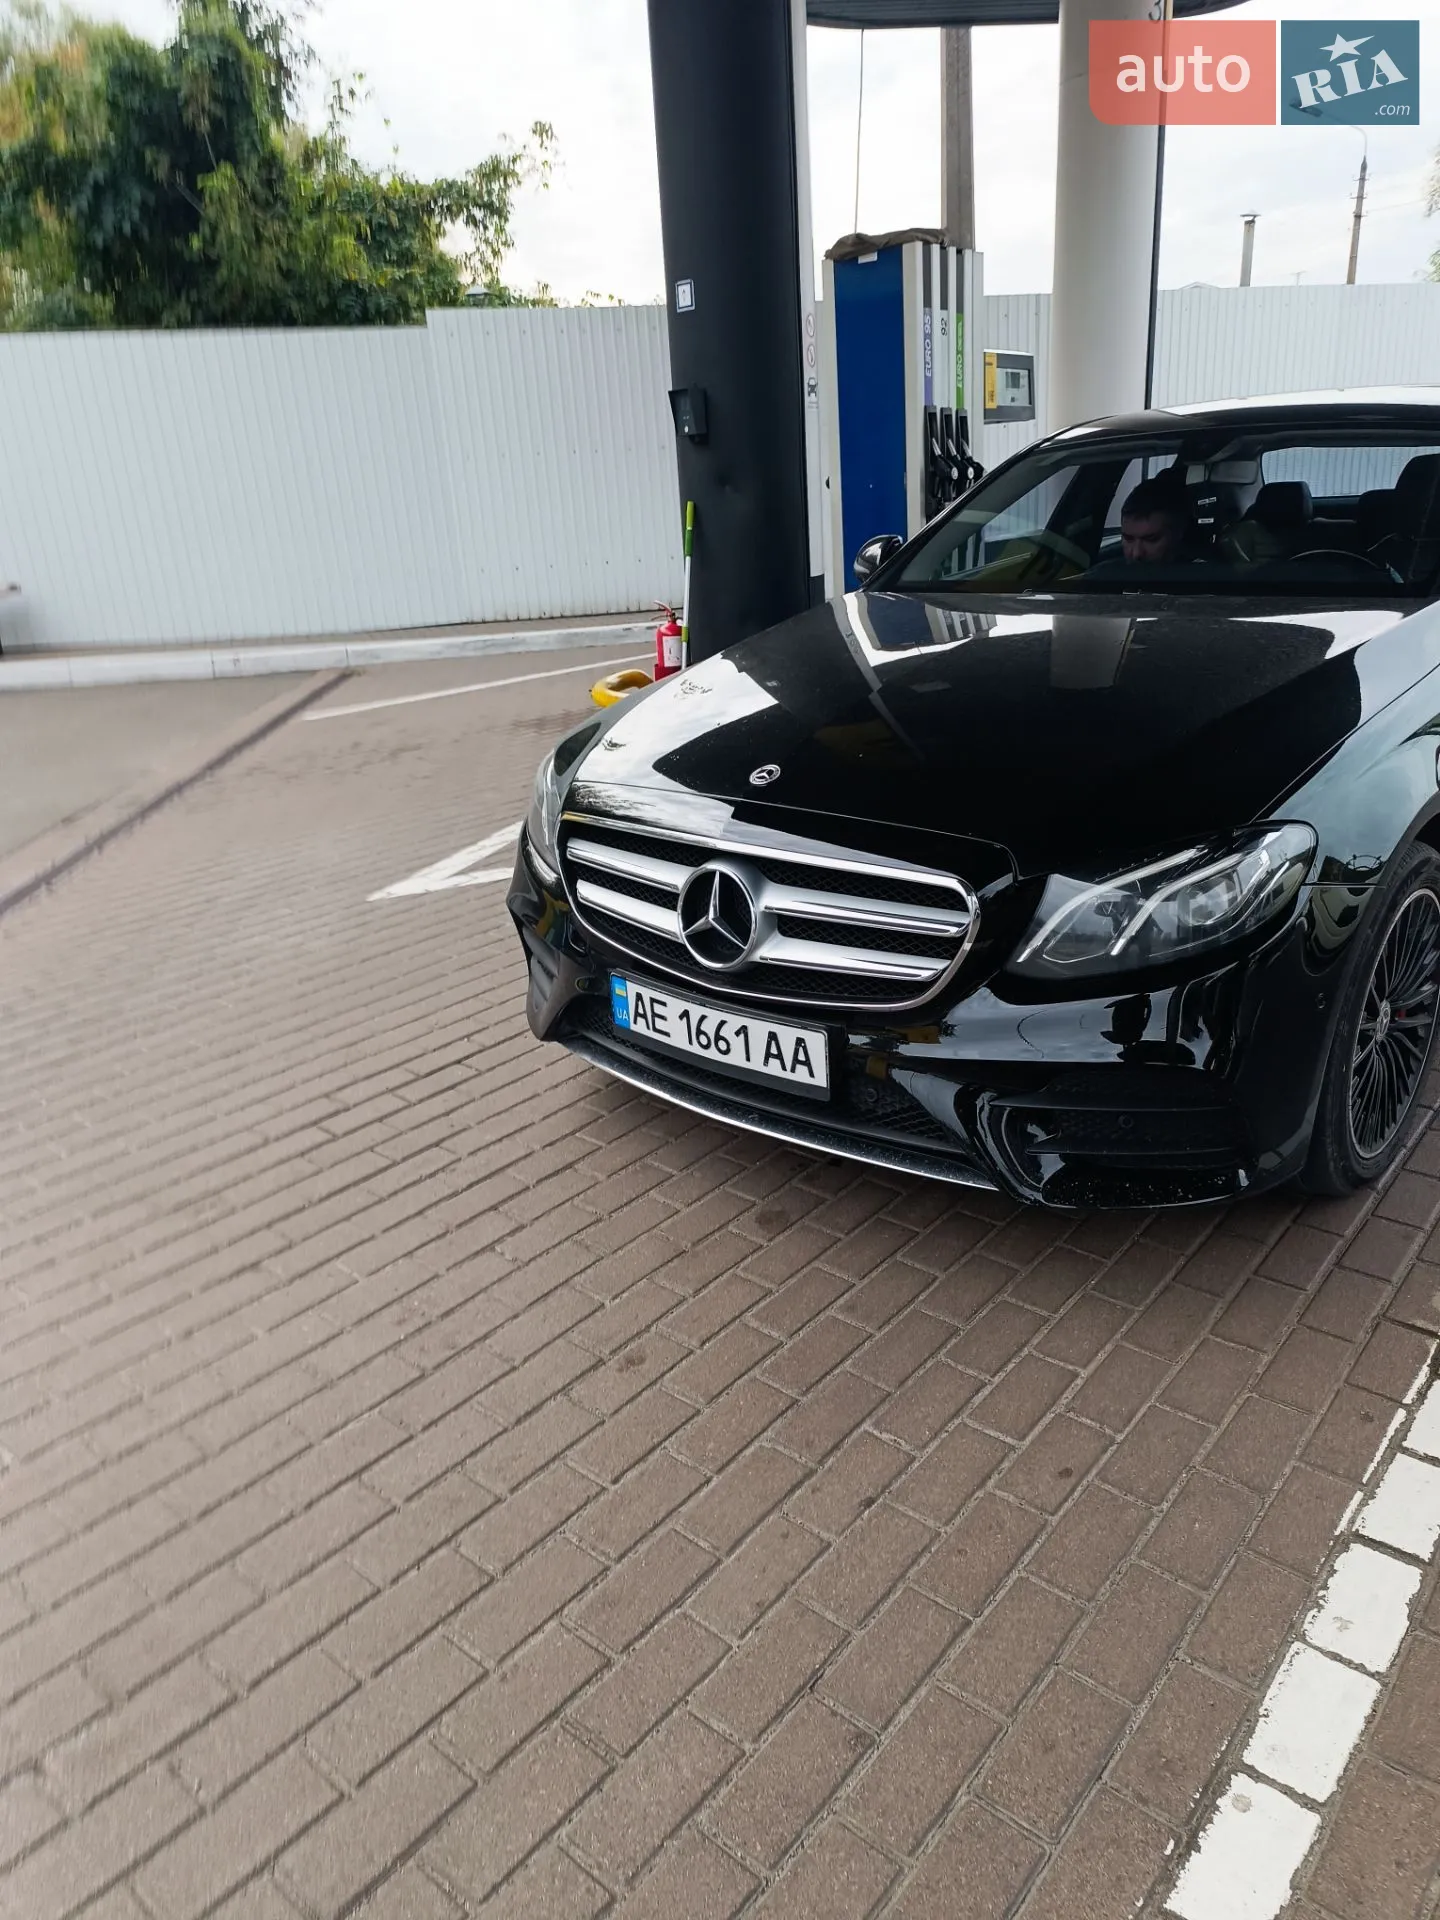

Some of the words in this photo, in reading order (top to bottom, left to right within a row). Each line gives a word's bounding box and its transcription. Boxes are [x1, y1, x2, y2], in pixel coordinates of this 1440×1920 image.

[924, 313, 931, 334] 95
[940, 317, 947, 336] 92
[924, 338, 932, 377] EURO
[616, 1007, 629, 1021] UA
[633, 991, 671, 1039] AE
[678, 1008, 751, 1063] 1661
[763, 1030, 815, 1079] AA
